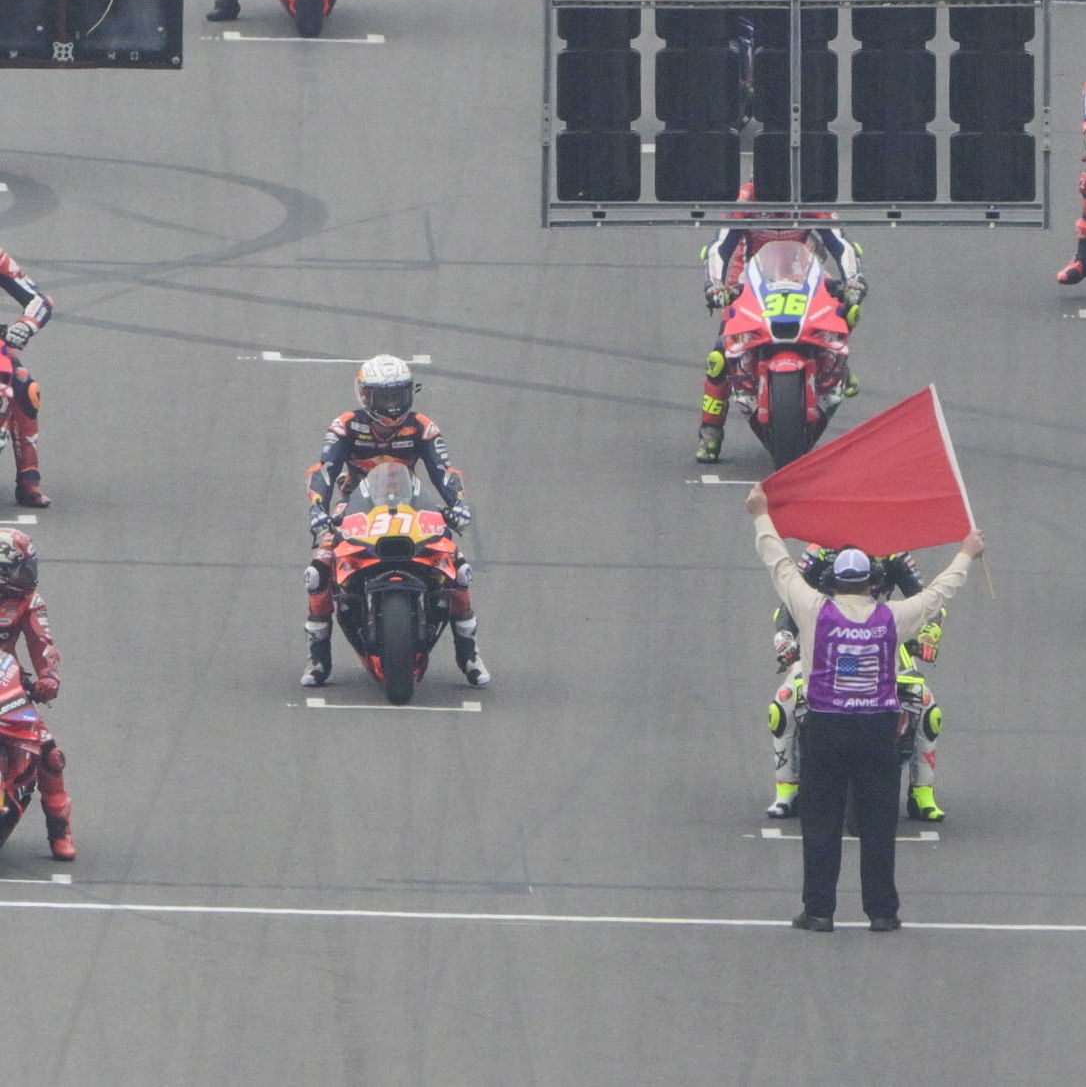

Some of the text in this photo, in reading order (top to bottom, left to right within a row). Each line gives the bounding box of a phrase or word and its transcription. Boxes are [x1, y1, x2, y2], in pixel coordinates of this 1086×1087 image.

[762, 292, 808, 317] 36
[370, 513, 414, 537] 37
[827, 625, 888, 641] MotoGP
[0, 697, 27, 714] enovo
[844, 697, 880, 709] AME
